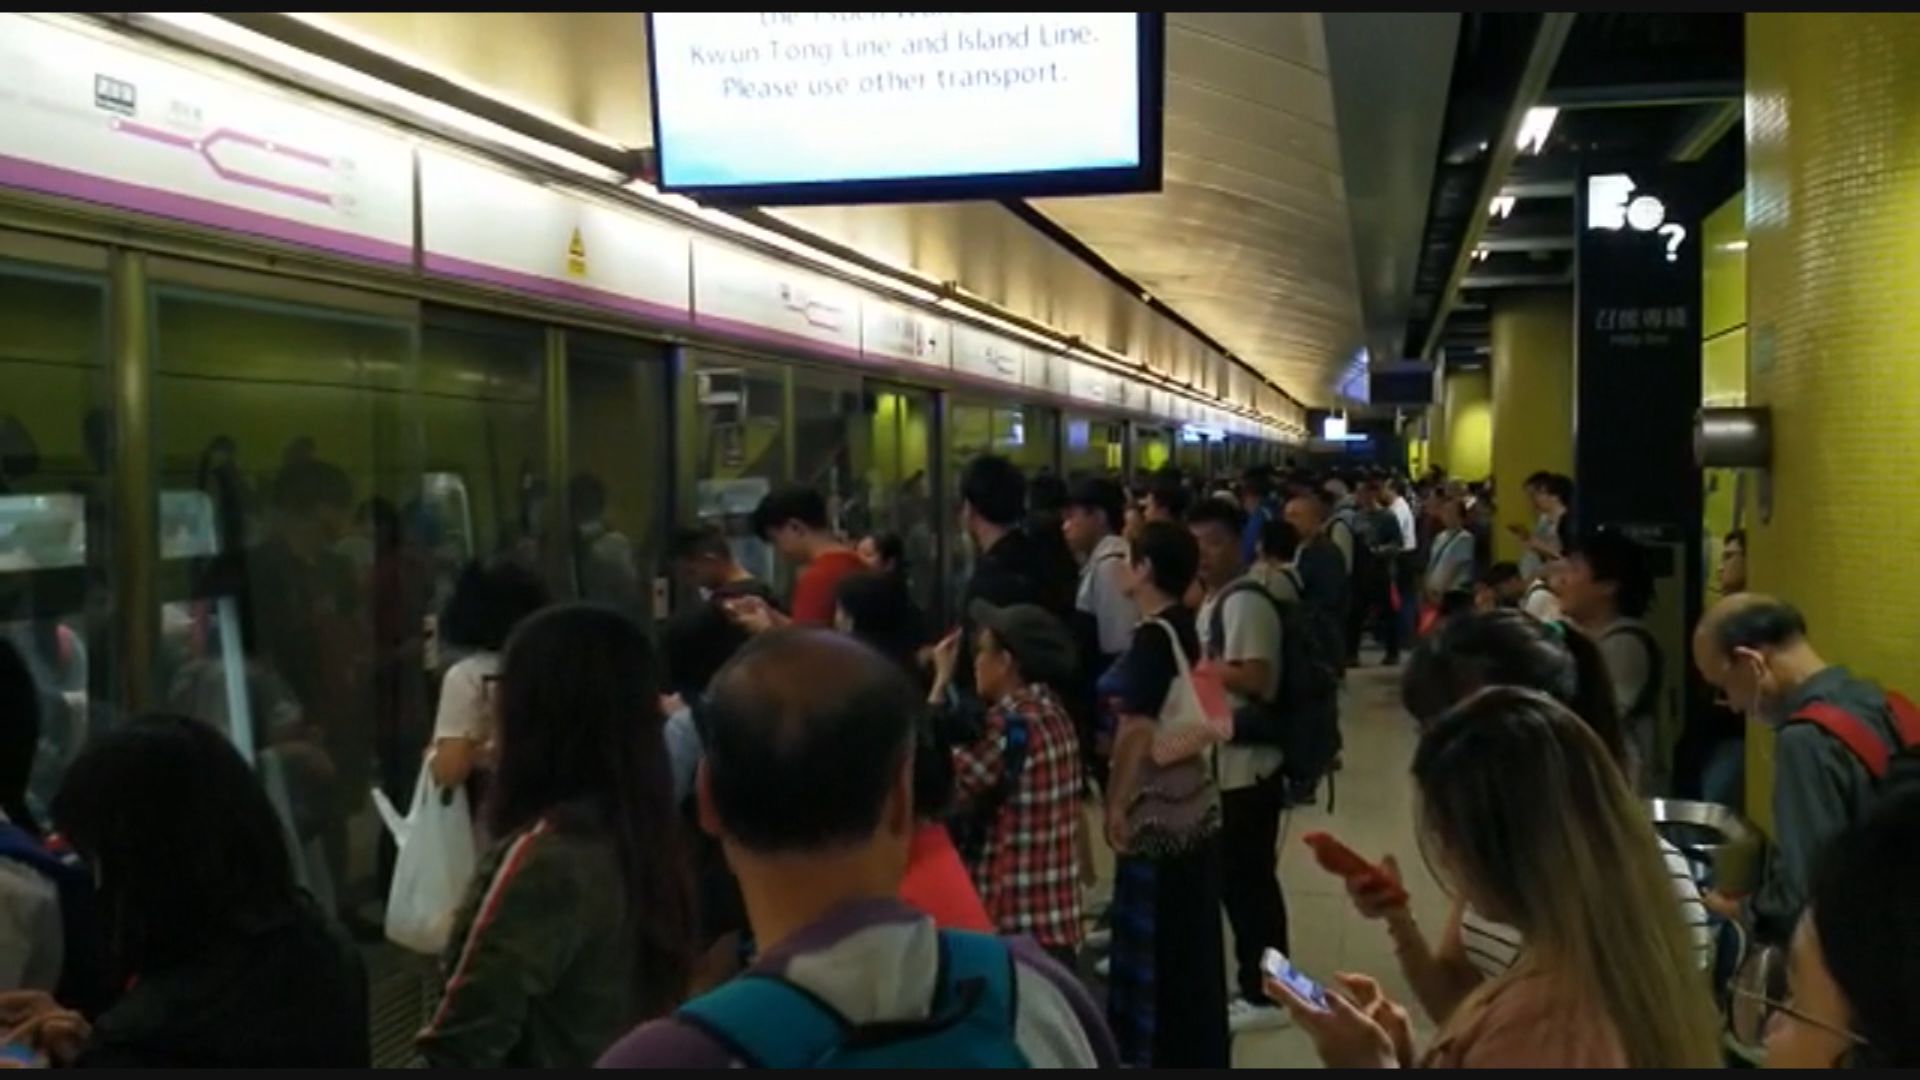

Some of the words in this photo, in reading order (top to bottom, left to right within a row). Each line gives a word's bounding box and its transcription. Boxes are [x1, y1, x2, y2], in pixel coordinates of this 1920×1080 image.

[690, 45, 760, 66] Kwun
[770, 40, 833, 65] Tong
[841, 37, 892, 57] Line
[901, 30, 949, 55] and
[958, 24, 1030, 51] Island
[1039, 22, 1100, 47] Line.
[721, 76, 799, 99] Please
[807, 77, 850, 97] use
[859, 70, 925, 93] other
[937, 62, 1069, 90] transport.
